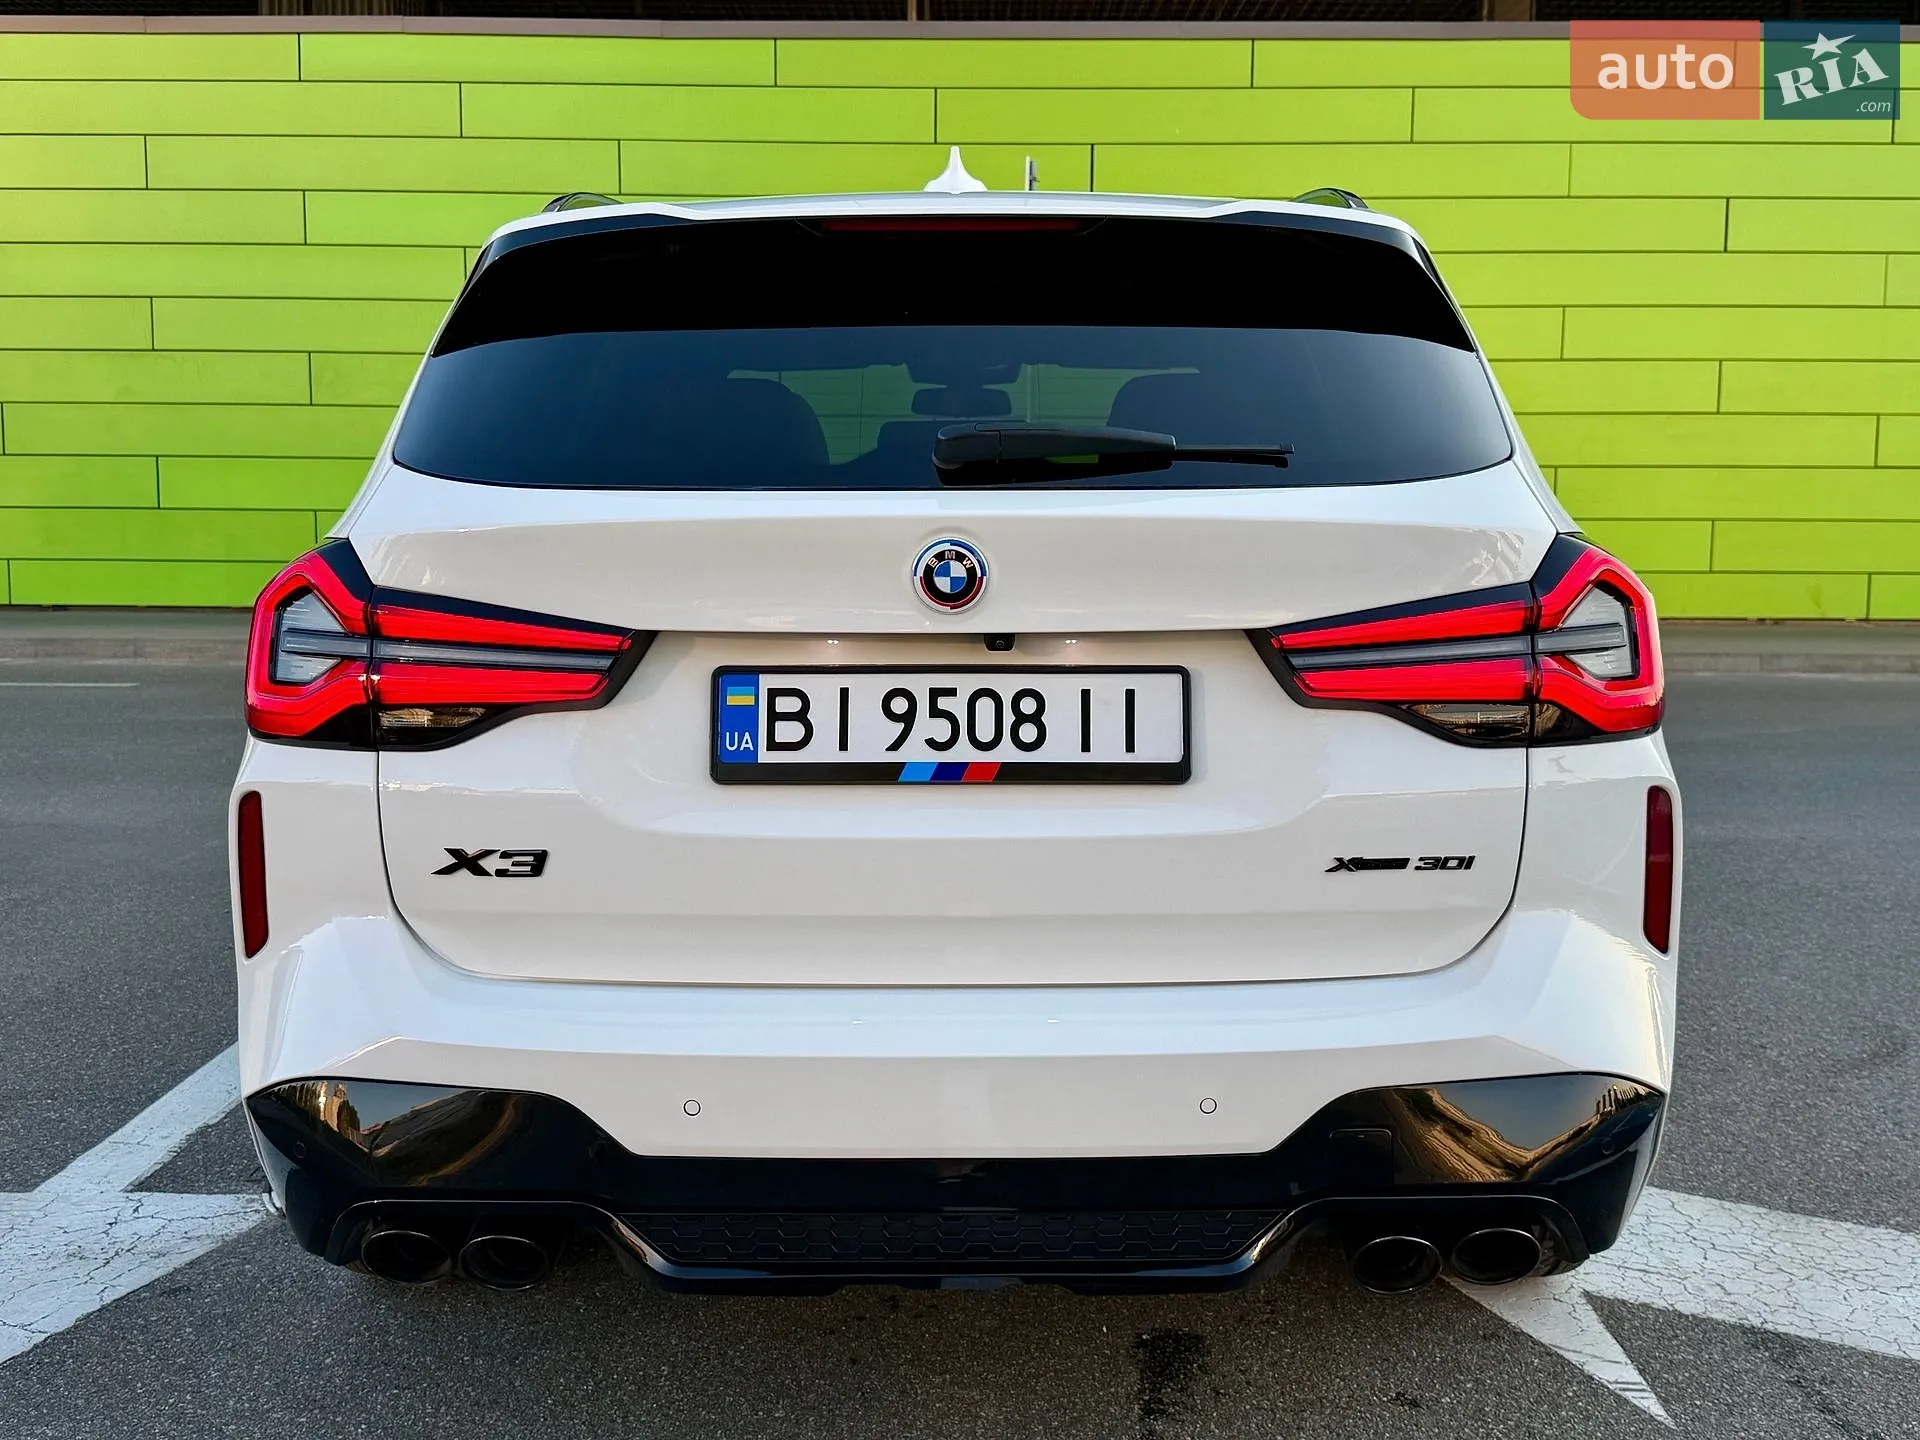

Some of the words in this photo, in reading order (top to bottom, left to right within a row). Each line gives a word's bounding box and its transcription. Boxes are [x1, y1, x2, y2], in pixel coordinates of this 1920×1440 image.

[927, 550, 974, 569] BMW
[766, 686, 850, 752] BI
[881, 686, 1047, 752] 9508
[725, 731, 754, 751] UA
[430, 847, 548, 878] X3
